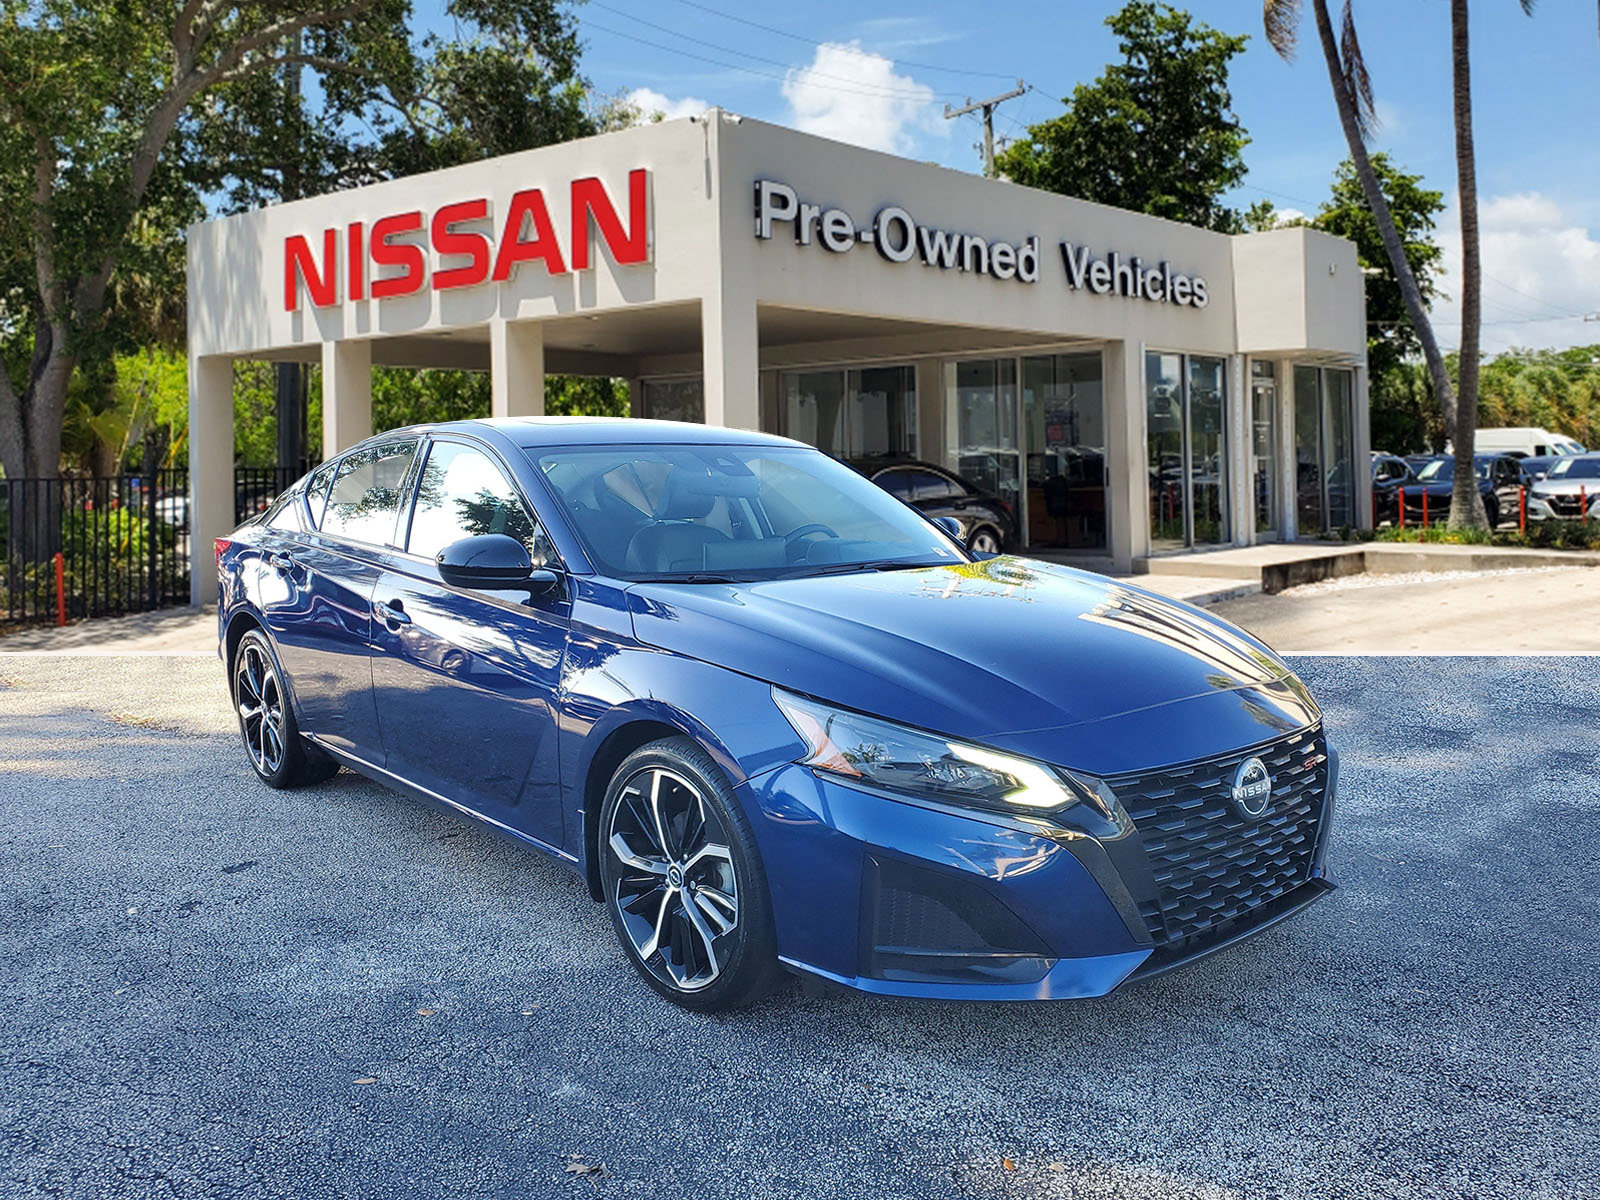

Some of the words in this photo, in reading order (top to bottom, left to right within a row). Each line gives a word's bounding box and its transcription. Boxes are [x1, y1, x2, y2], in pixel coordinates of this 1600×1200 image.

[284, 168, 648, 312] NISSAN
[754, 180, 1039, 283] Pre-Owned
[1059, 242, 1208, 308] Vehicles
[1234, 781, 1269, 800] NISSA
